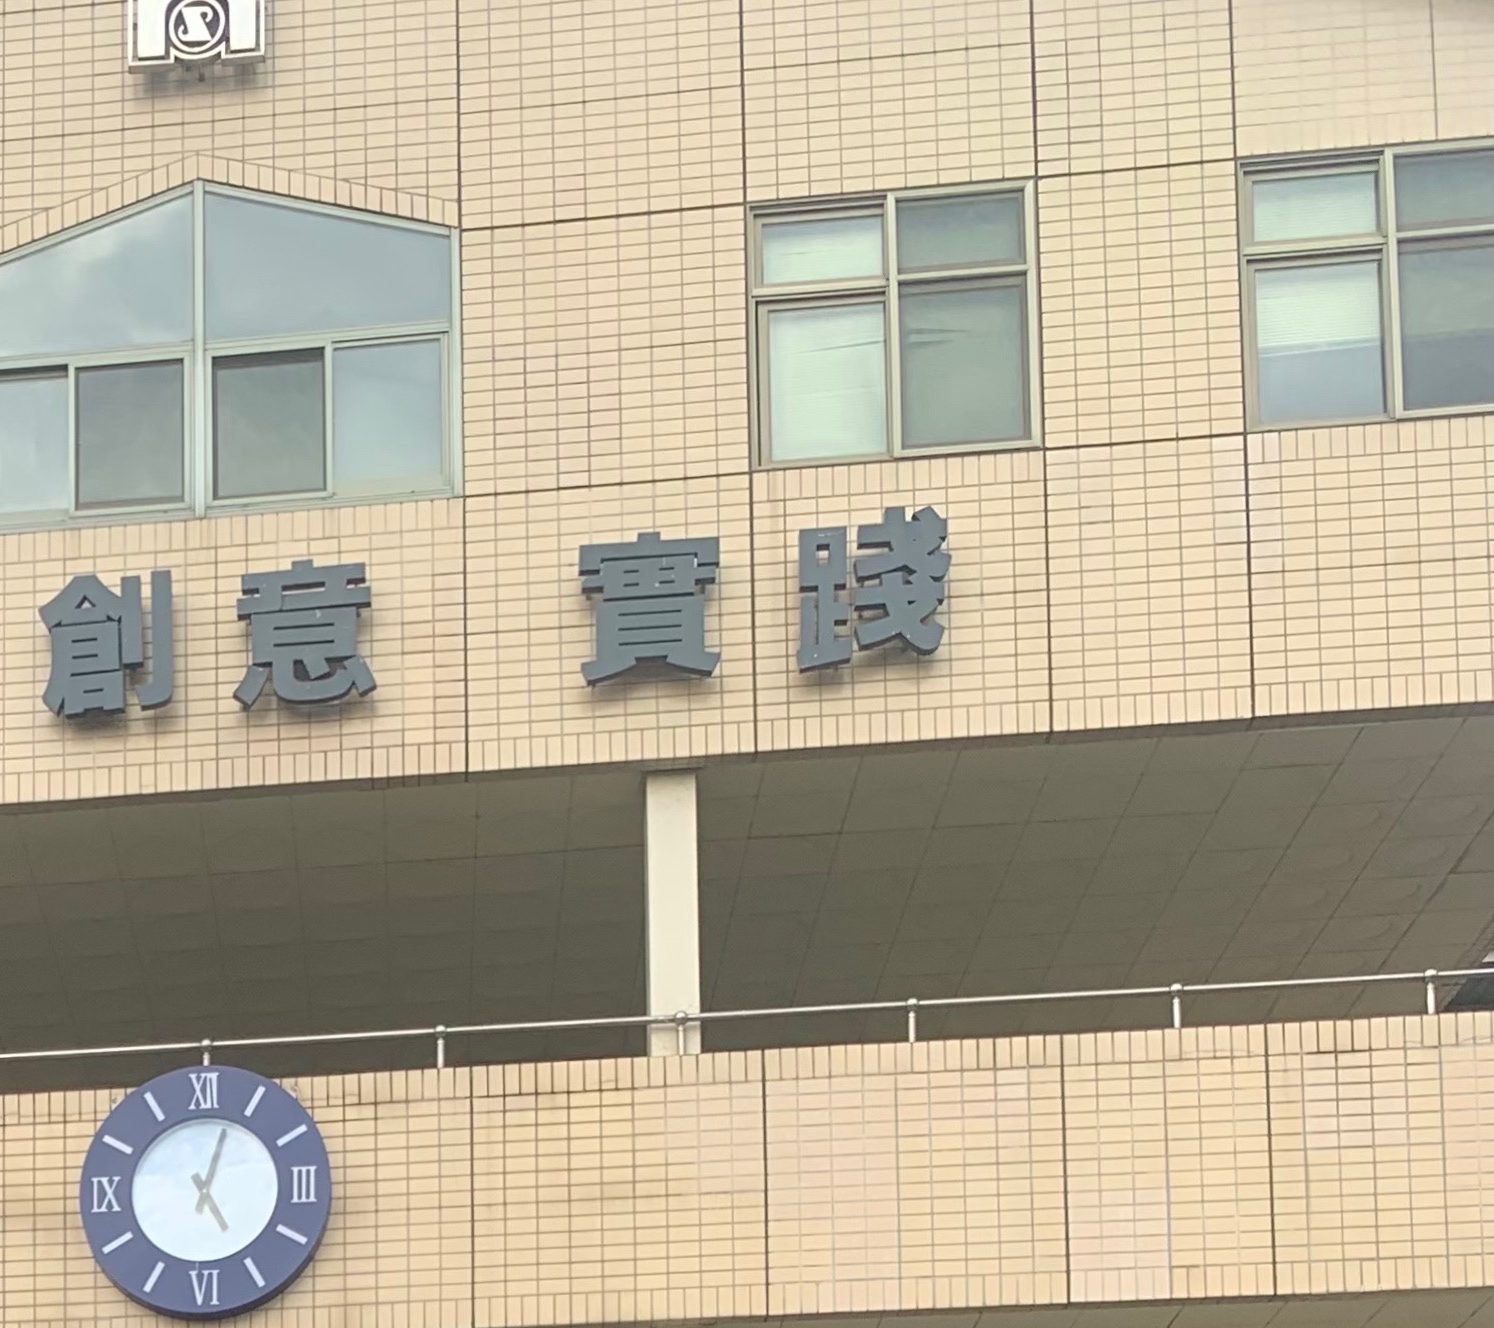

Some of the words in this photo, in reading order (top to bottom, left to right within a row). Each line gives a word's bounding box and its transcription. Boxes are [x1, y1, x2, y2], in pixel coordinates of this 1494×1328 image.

[38, 557, 377, 720] 創意
[578, 505, 953, 689] 實踐
[188, 1071, 220, 1110] XII
[90, 1175, 122, 1213] IX
[290, 1165, 318, 1203] III
[188, 1269, 220, 1306] VI
